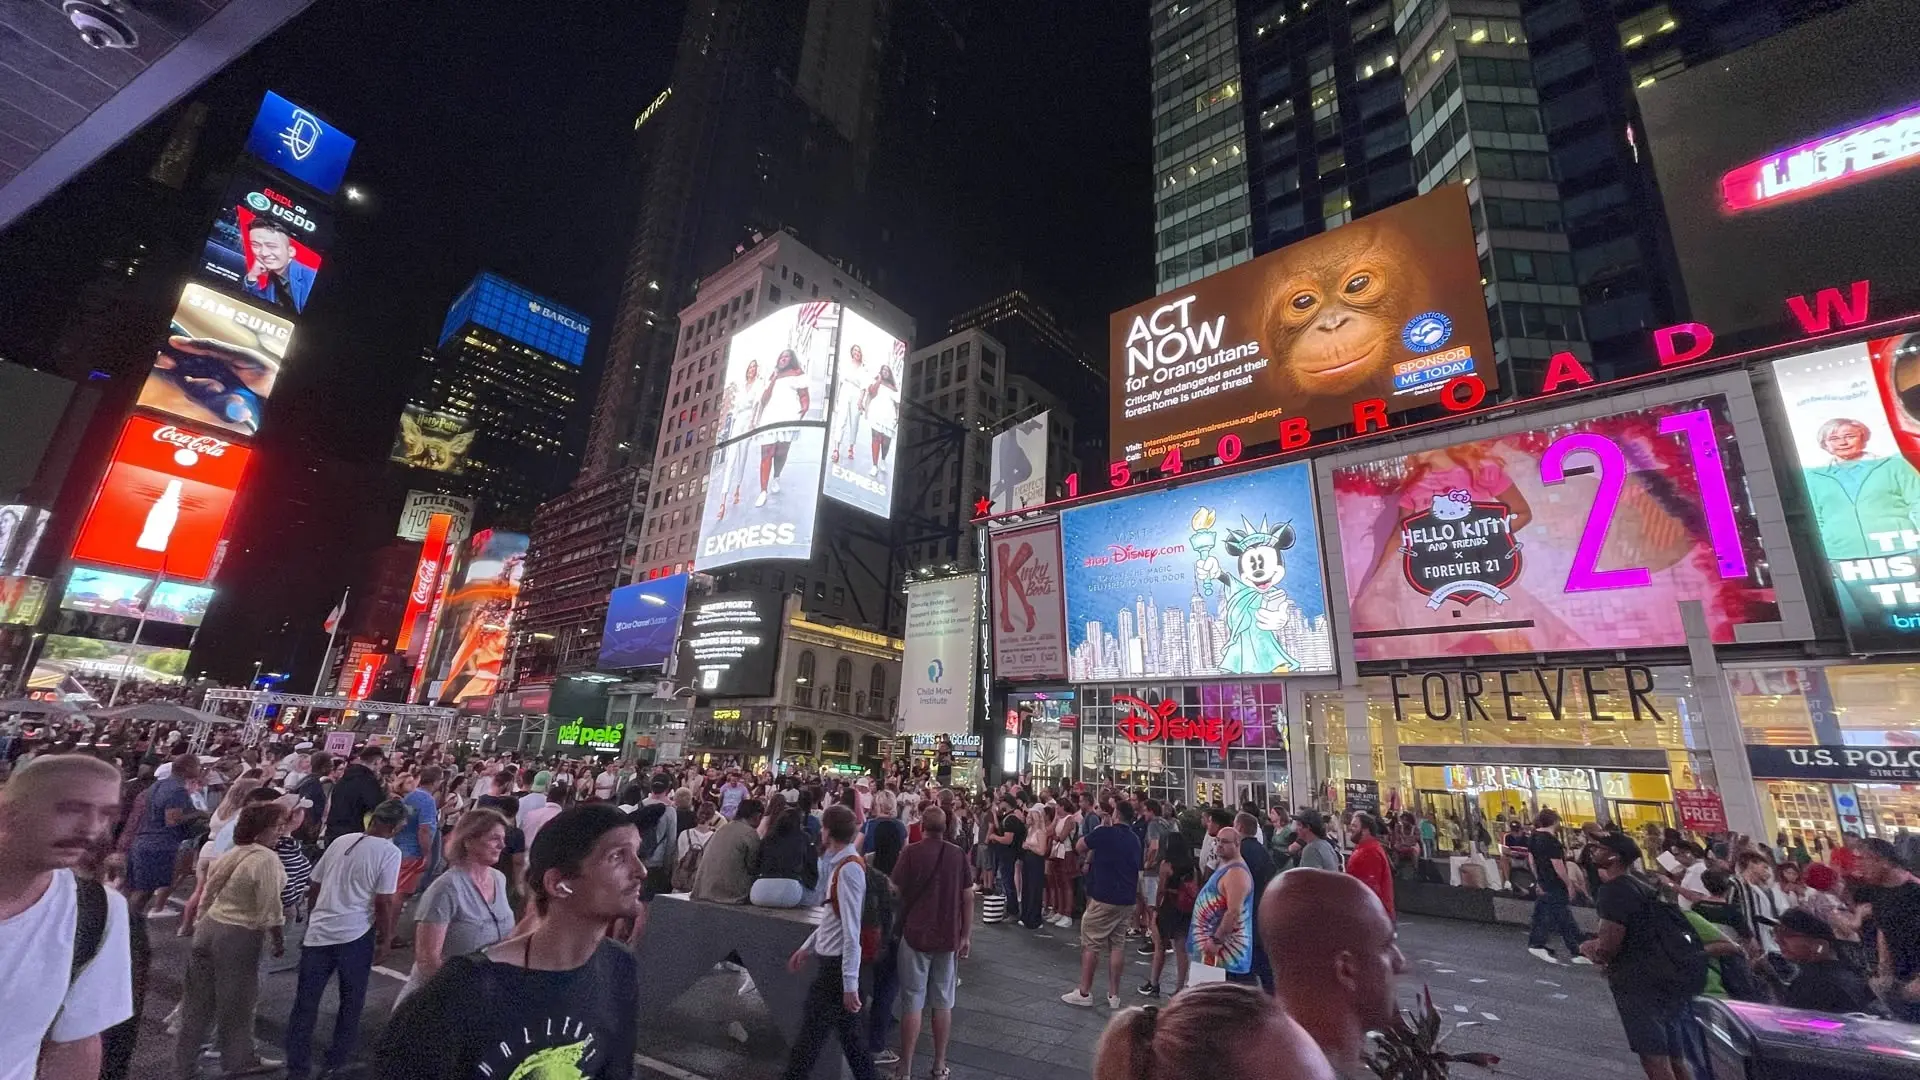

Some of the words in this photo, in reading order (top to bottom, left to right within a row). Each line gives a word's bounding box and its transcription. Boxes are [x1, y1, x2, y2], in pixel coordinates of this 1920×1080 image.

[271, 204, 316, 232] USDD
[189, 293, 289, 340] SAMSUNG
[542, 306, 590, 334] BARCLAY
[1126, 294, 1197, 348] ACT
[1128, 314, 1226, 377] NOW
[1125, 375, 1150, 393] for
[1152, 340, 1260, 384] Orangutans
[1399, 348, 1467, 374] SPONSOR
[1401, 372, 1421, 386] ME
[1423, 360, 1468, 380] TODAY
[1125, 389, 1162, 408] Critically
[1163, 370, 1221, 397] endangered
[1222, 365, 1243, 379] and
[1243, 357, 1269, 373] their
[1125, 403, 1152, 419] forest
[1152, 397, 1179, 411] home
[1180, 393, 1190, 403] is
[1190, 384, 1220, 400] under
[1222, 374, 1253, 391] threat
[417, 413, 441, 429] Harry
[437, 417, 463, 434] Potter
[152, 425, 226, 458] Coca-Cola
[831, 463, 887, 497] EXPRESS
[413, 495, 447, 507] LITTLE
[1540, 408, 1749, 593] 21
[704, 522, 796, 556] EXPRESS
[1402, 524, 1455, 547] HELLO
[1461, 514, 1511, 538] KITTY
[1428, 542, 1448, 552] AND
[1452, 537, 1488, 549] FRIENDS
[412, 558, 437, 605] Coca-Cola
[1148, 565, 1172, 574] MAGIC
[1162, 573, 1186, 583] DOOR
[1424, 561, 1481, 579] FOREVER
[1486, 559, 1500, 572] 21
[1839, 555, 1911, 581] HIS
[917, 687, 935, 697] Child
[935, 686, 953, 697] Mind
[1388, 663, 1665, 724] FOREVER
[1786, 748, 1840, 766] U.S.
[1868, 768, 1911, 778] SINCE
[1605, 779, 1626, 796] 21
[1681, 806, 1722, 823] FREE
